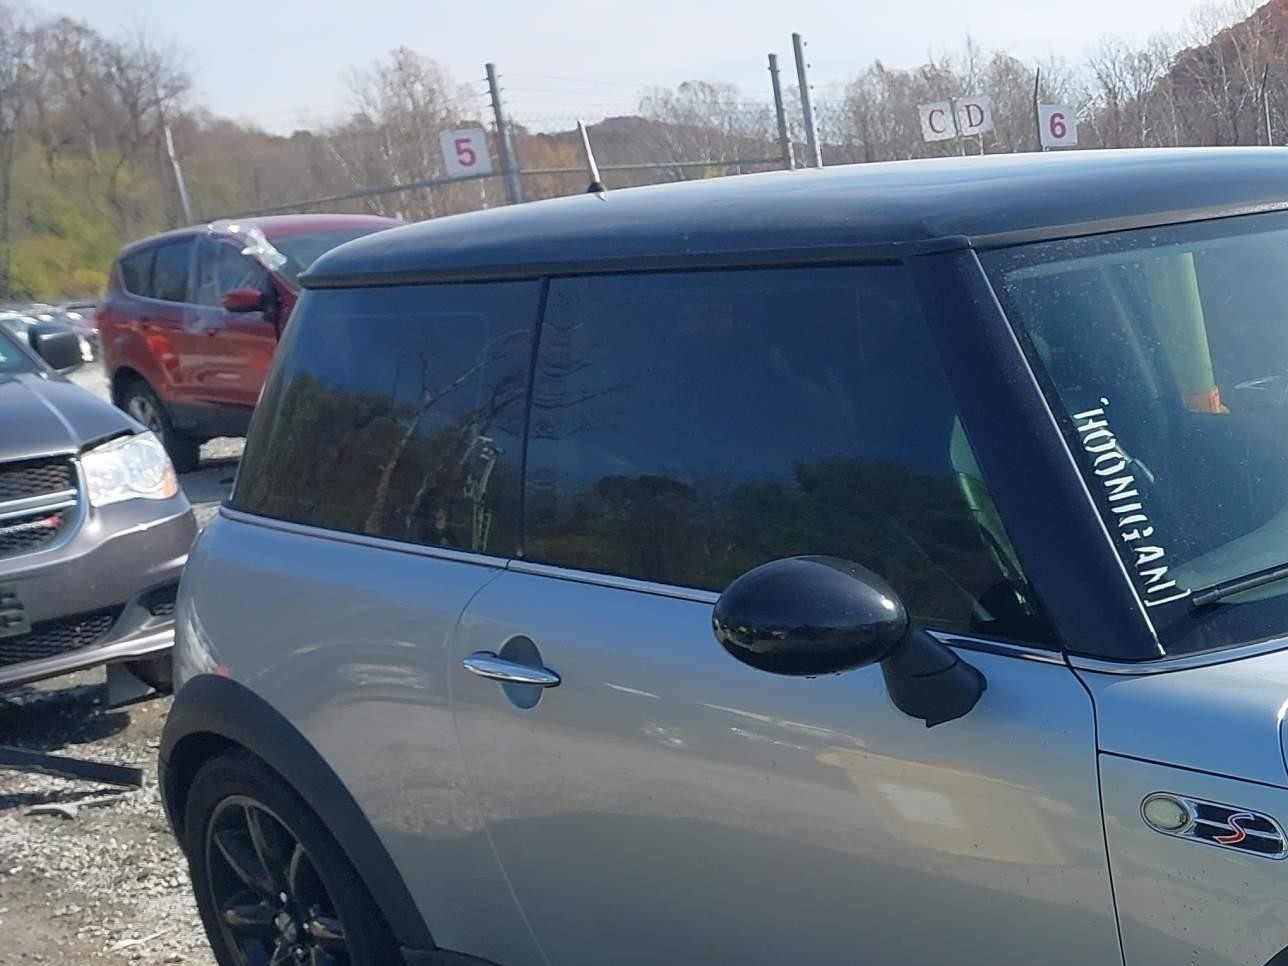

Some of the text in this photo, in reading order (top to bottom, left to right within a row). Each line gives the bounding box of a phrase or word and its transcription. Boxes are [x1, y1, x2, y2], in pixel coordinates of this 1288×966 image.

[928, 109, 946, 133] C
[964, 103, 985, 128] D
[1049, 112, 1067, 139] 6
[454, 137, 476, 167] 5
[1212, 812, 1255, 844] S
